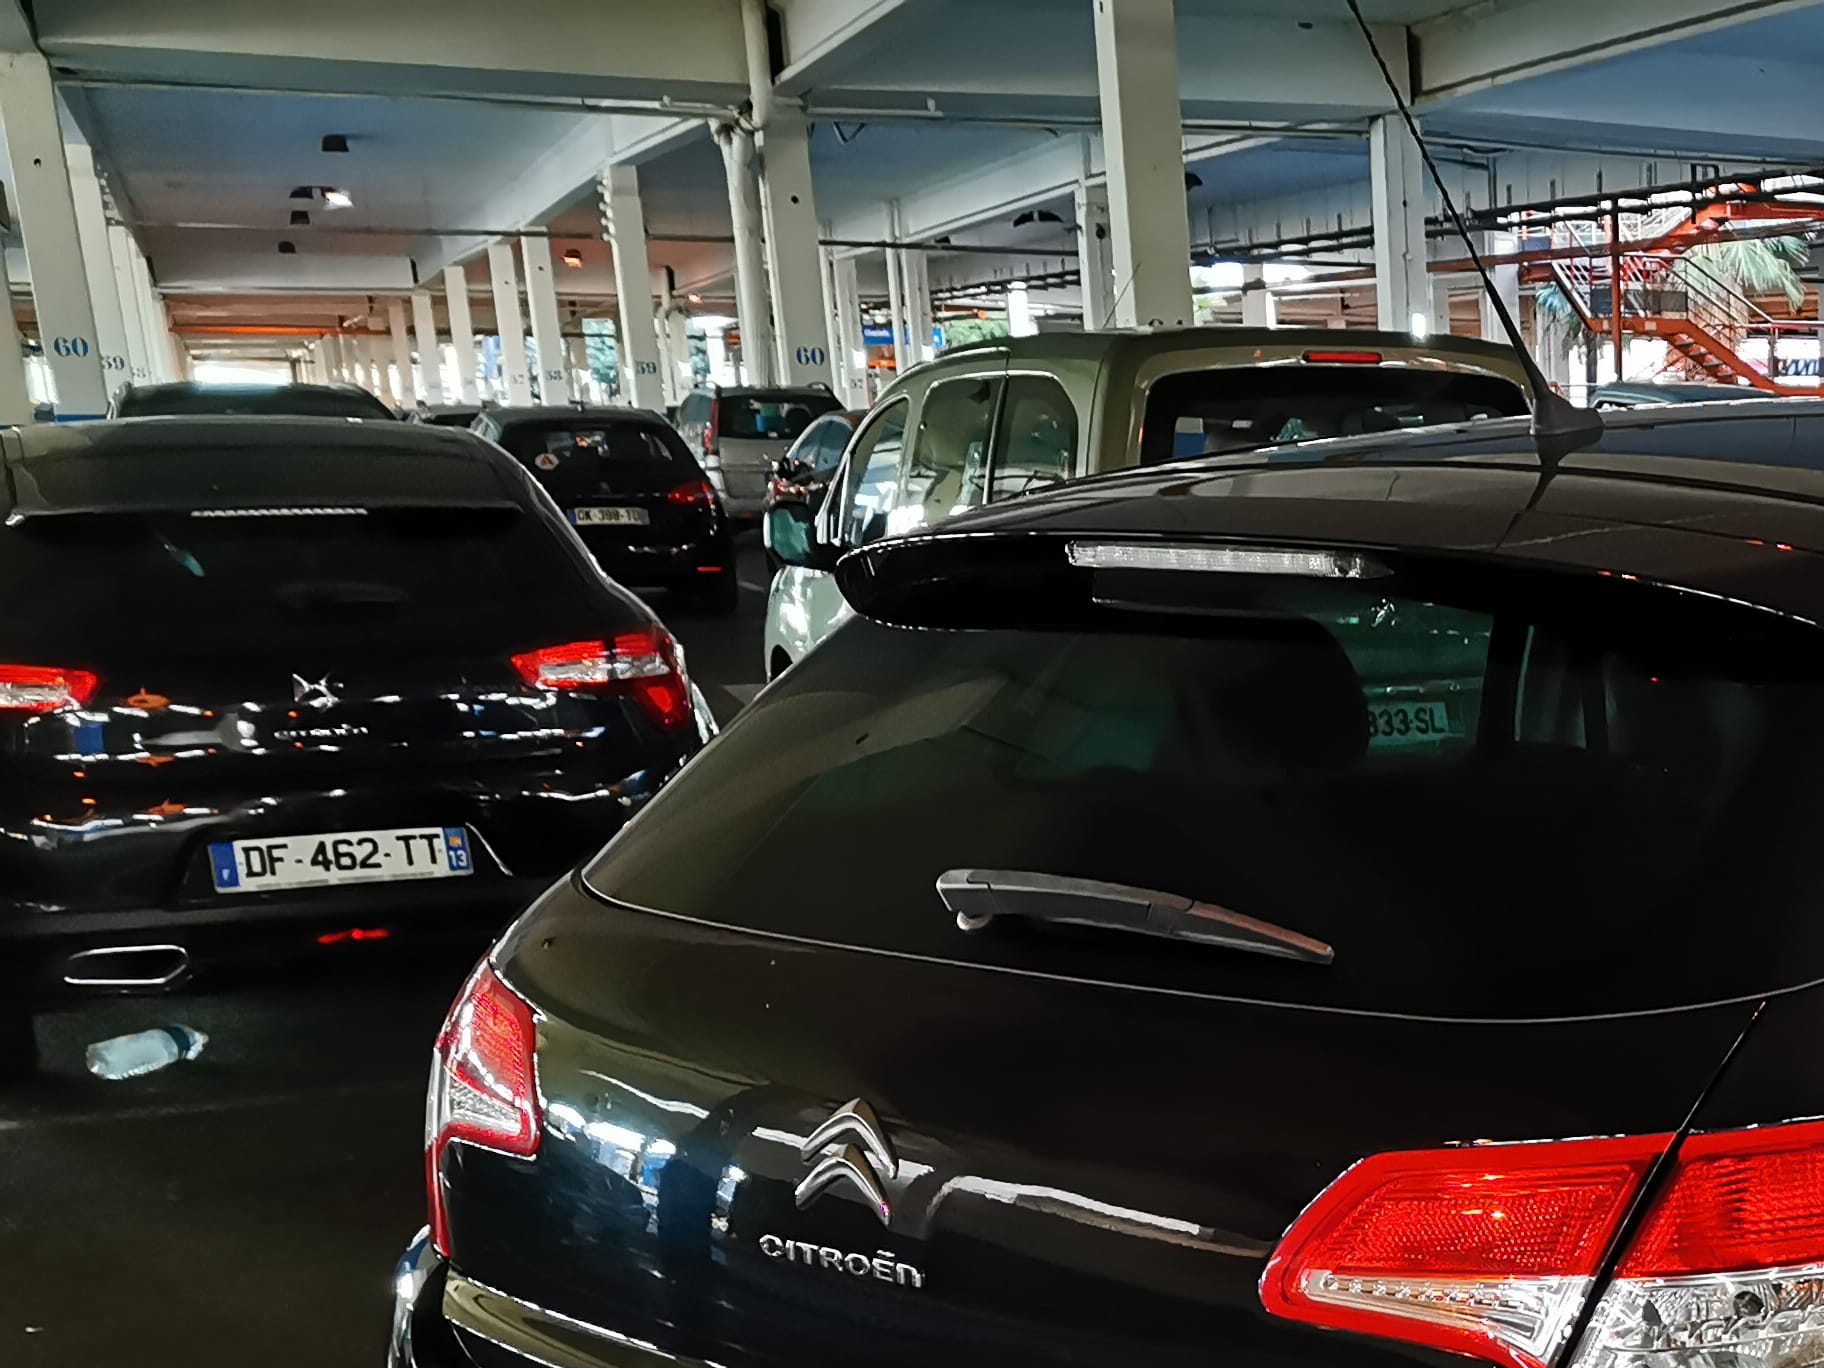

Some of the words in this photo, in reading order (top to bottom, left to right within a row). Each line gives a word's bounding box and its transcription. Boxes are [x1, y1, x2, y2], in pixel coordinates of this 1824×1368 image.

[53, 336, 89, 358] 60
[796, 346, 825, 366] 60
[241, 834, 440, 878] DF-462-TT
[449, 850, 467, 866] 13
